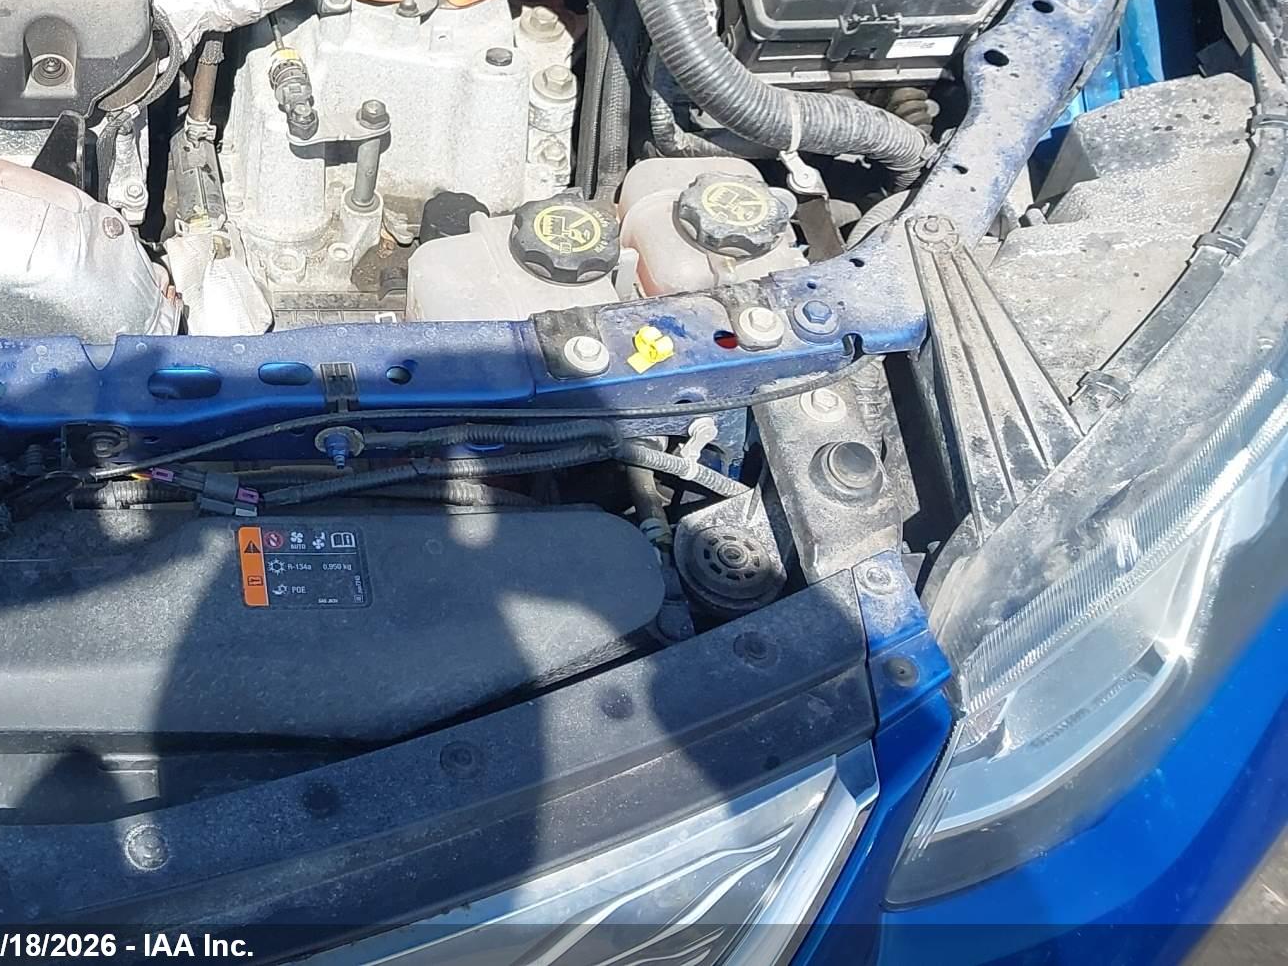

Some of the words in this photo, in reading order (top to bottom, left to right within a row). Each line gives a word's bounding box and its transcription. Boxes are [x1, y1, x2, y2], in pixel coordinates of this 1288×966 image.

[322, 563, 342, 571] 0.950
[343, 563, 352, 571] kg
[291, 585, 307, 594] POE
